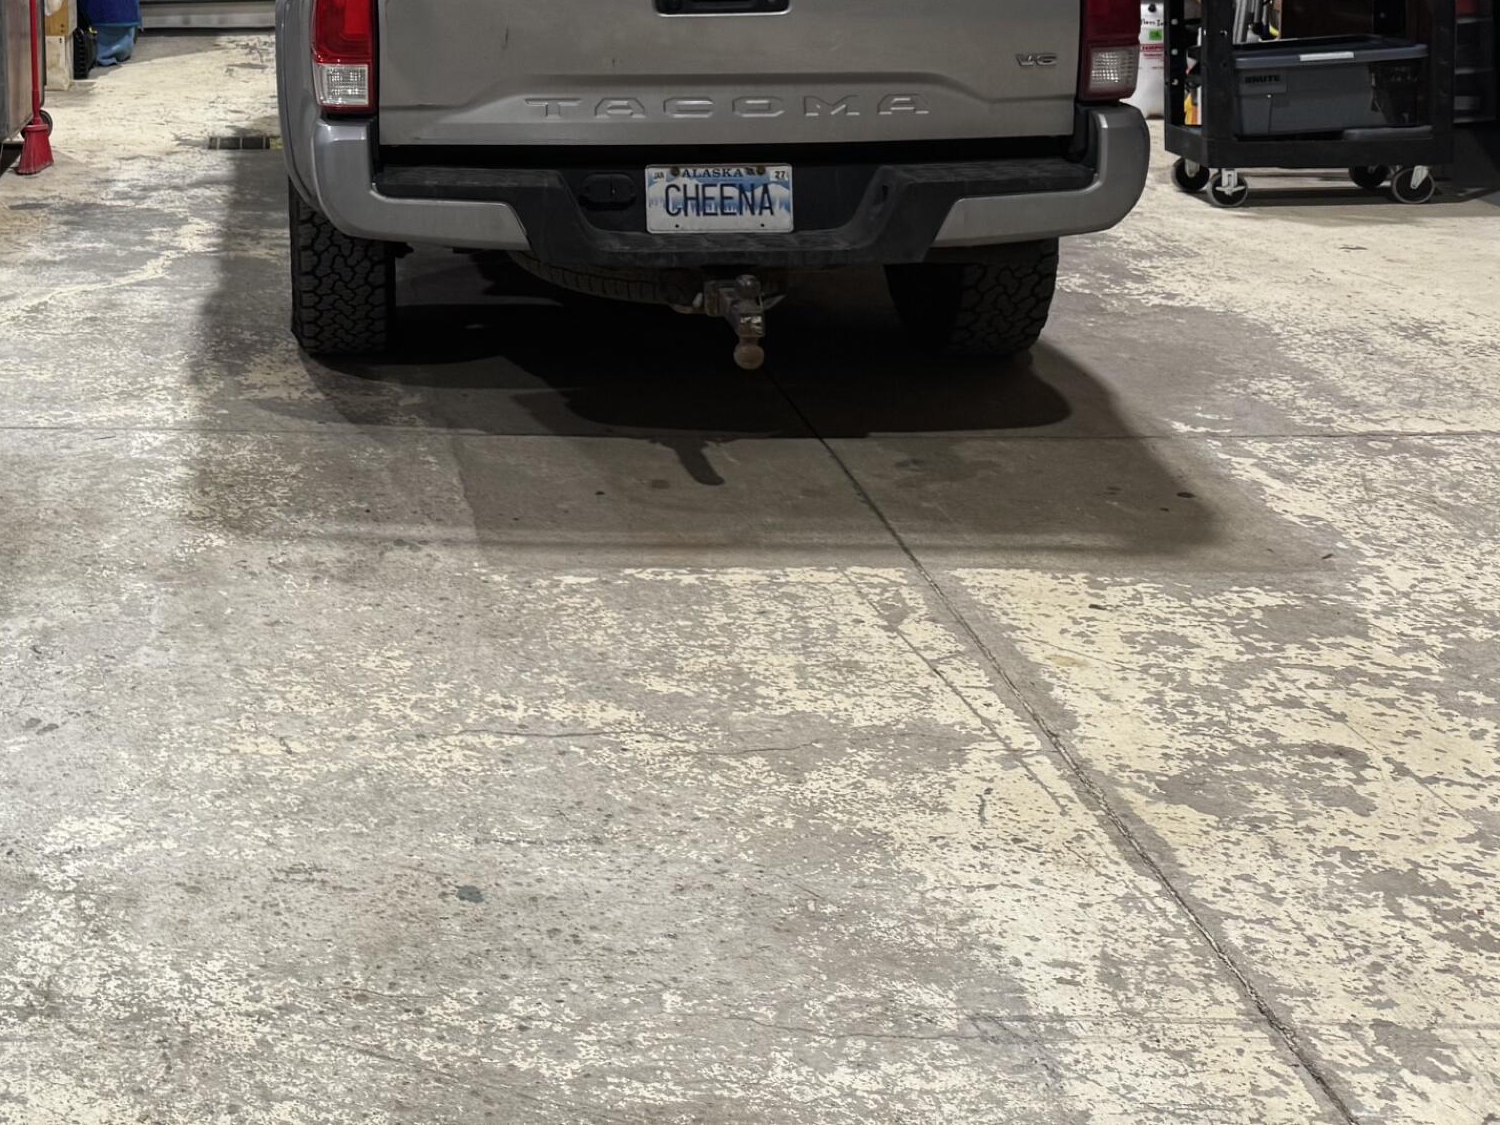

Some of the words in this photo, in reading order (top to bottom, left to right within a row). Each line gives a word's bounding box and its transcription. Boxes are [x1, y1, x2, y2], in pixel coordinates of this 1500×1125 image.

[1015, 53, 1057, 66] V6
[524, 94, 930, 119] TACOMA
[681, 168, 743, 178] ALASKA
[665, 183, 775, 217] CHEENA
